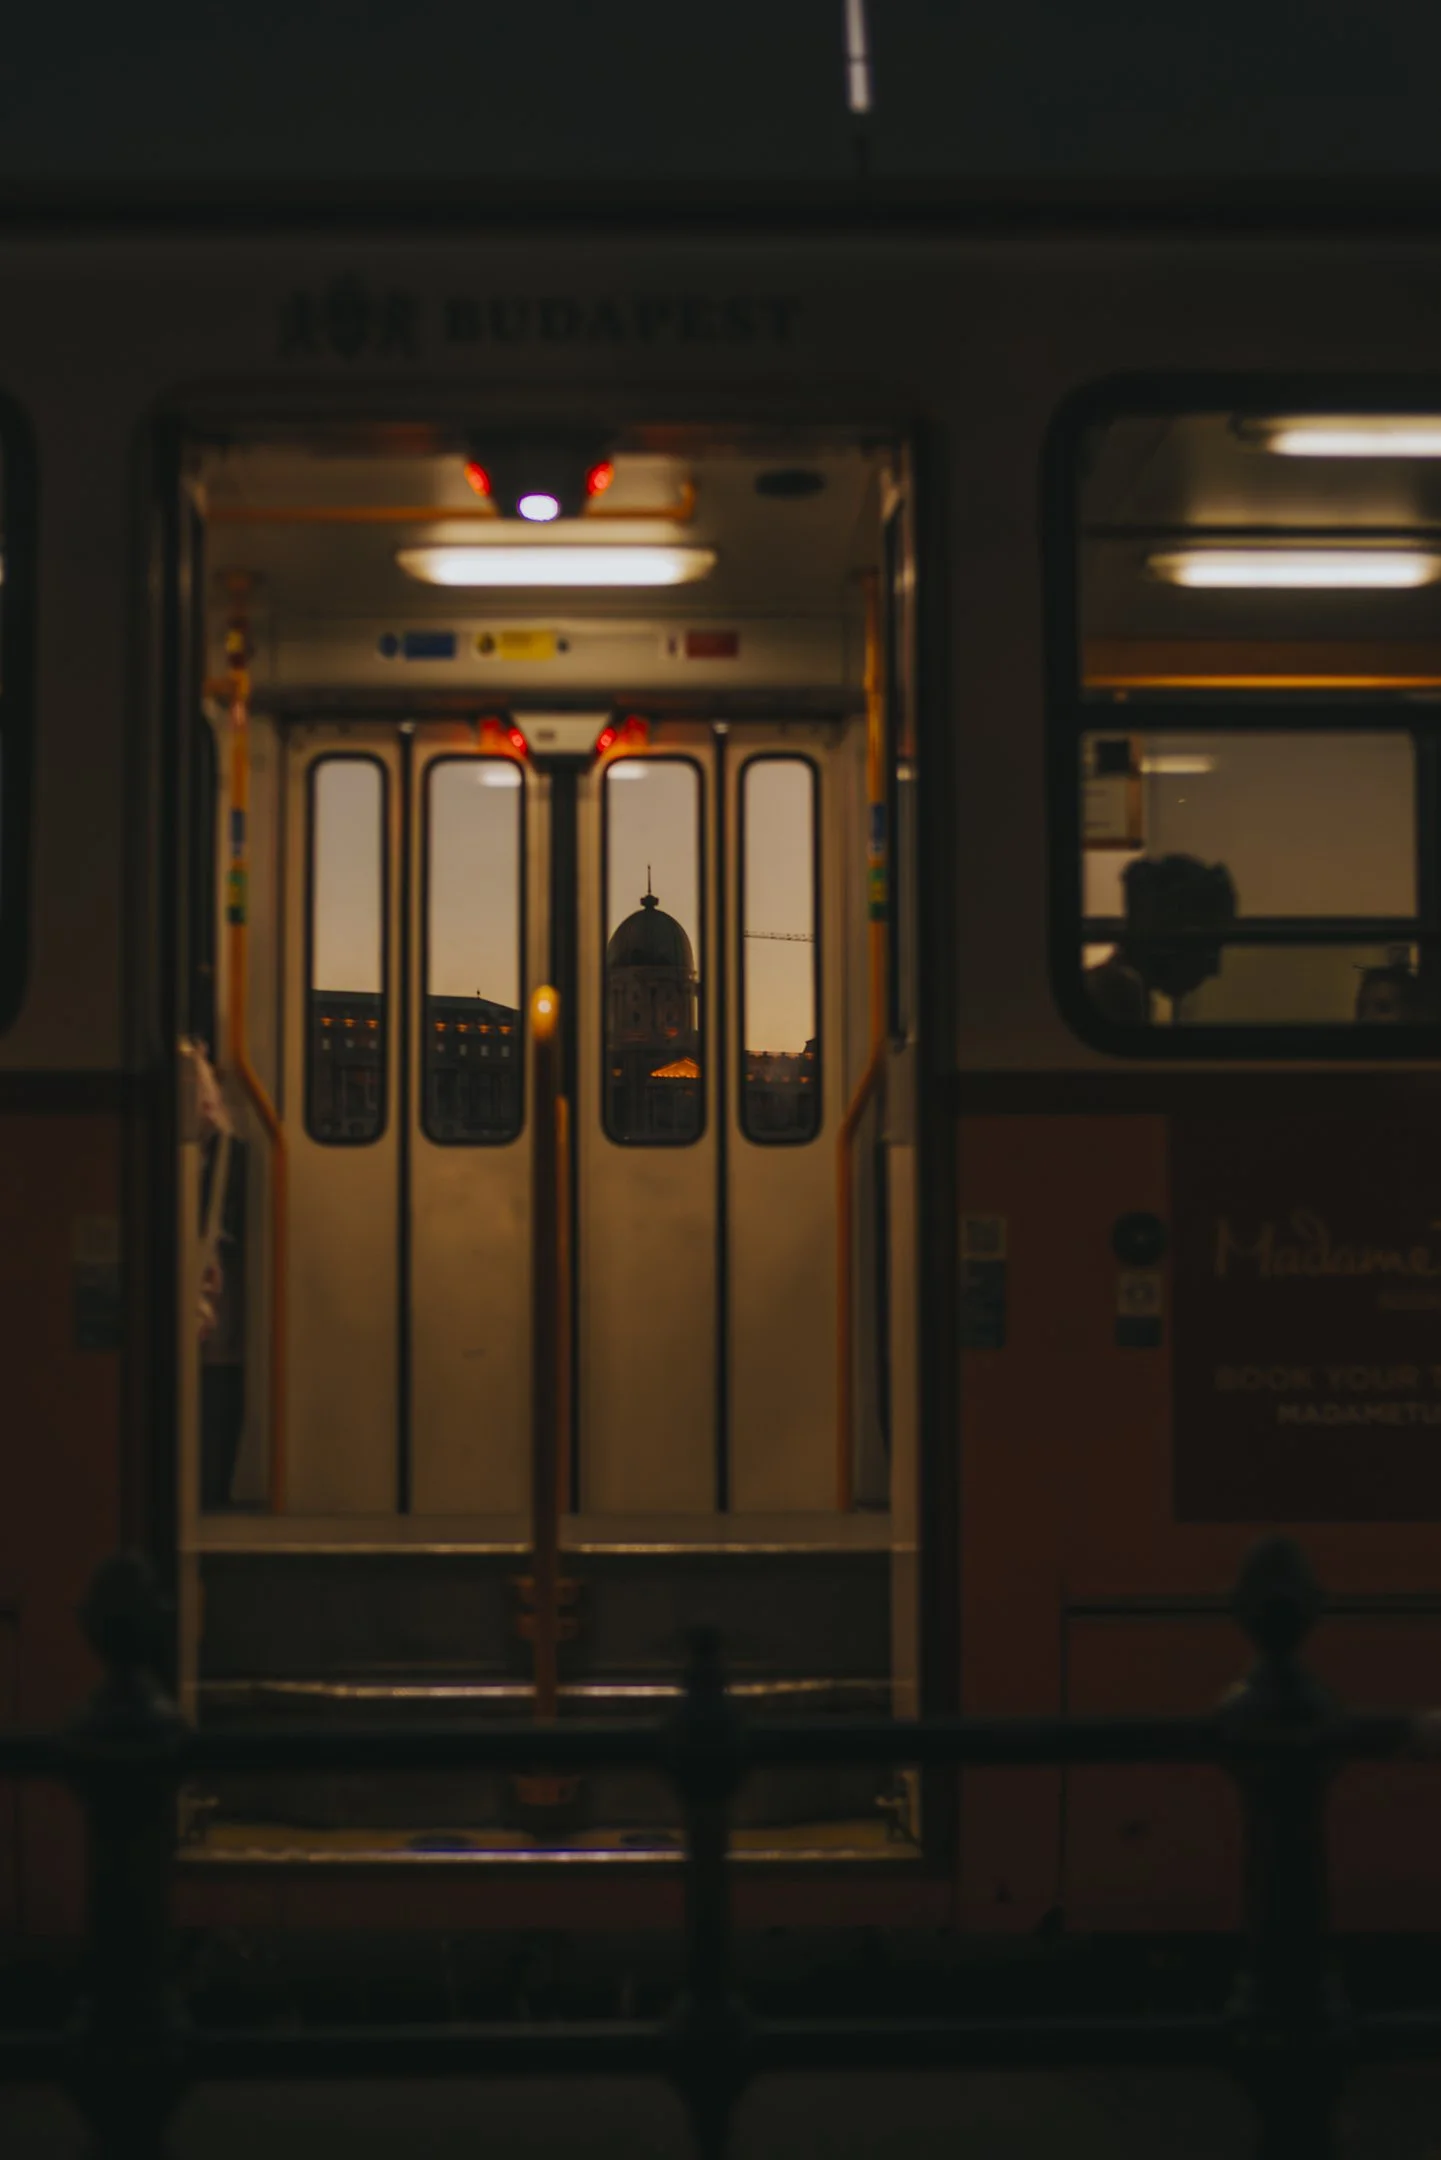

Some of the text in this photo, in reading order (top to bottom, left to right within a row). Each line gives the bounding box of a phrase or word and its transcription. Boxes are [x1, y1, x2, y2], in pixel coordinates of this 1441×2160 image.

[444, 296, 802, 344] BUDAPEST
[1215, 1208, 1433, 1280] Madame
[1215, 1365, 1312, 1391] BOOK
[1325, 1365, 1420, 1391] YOUR
